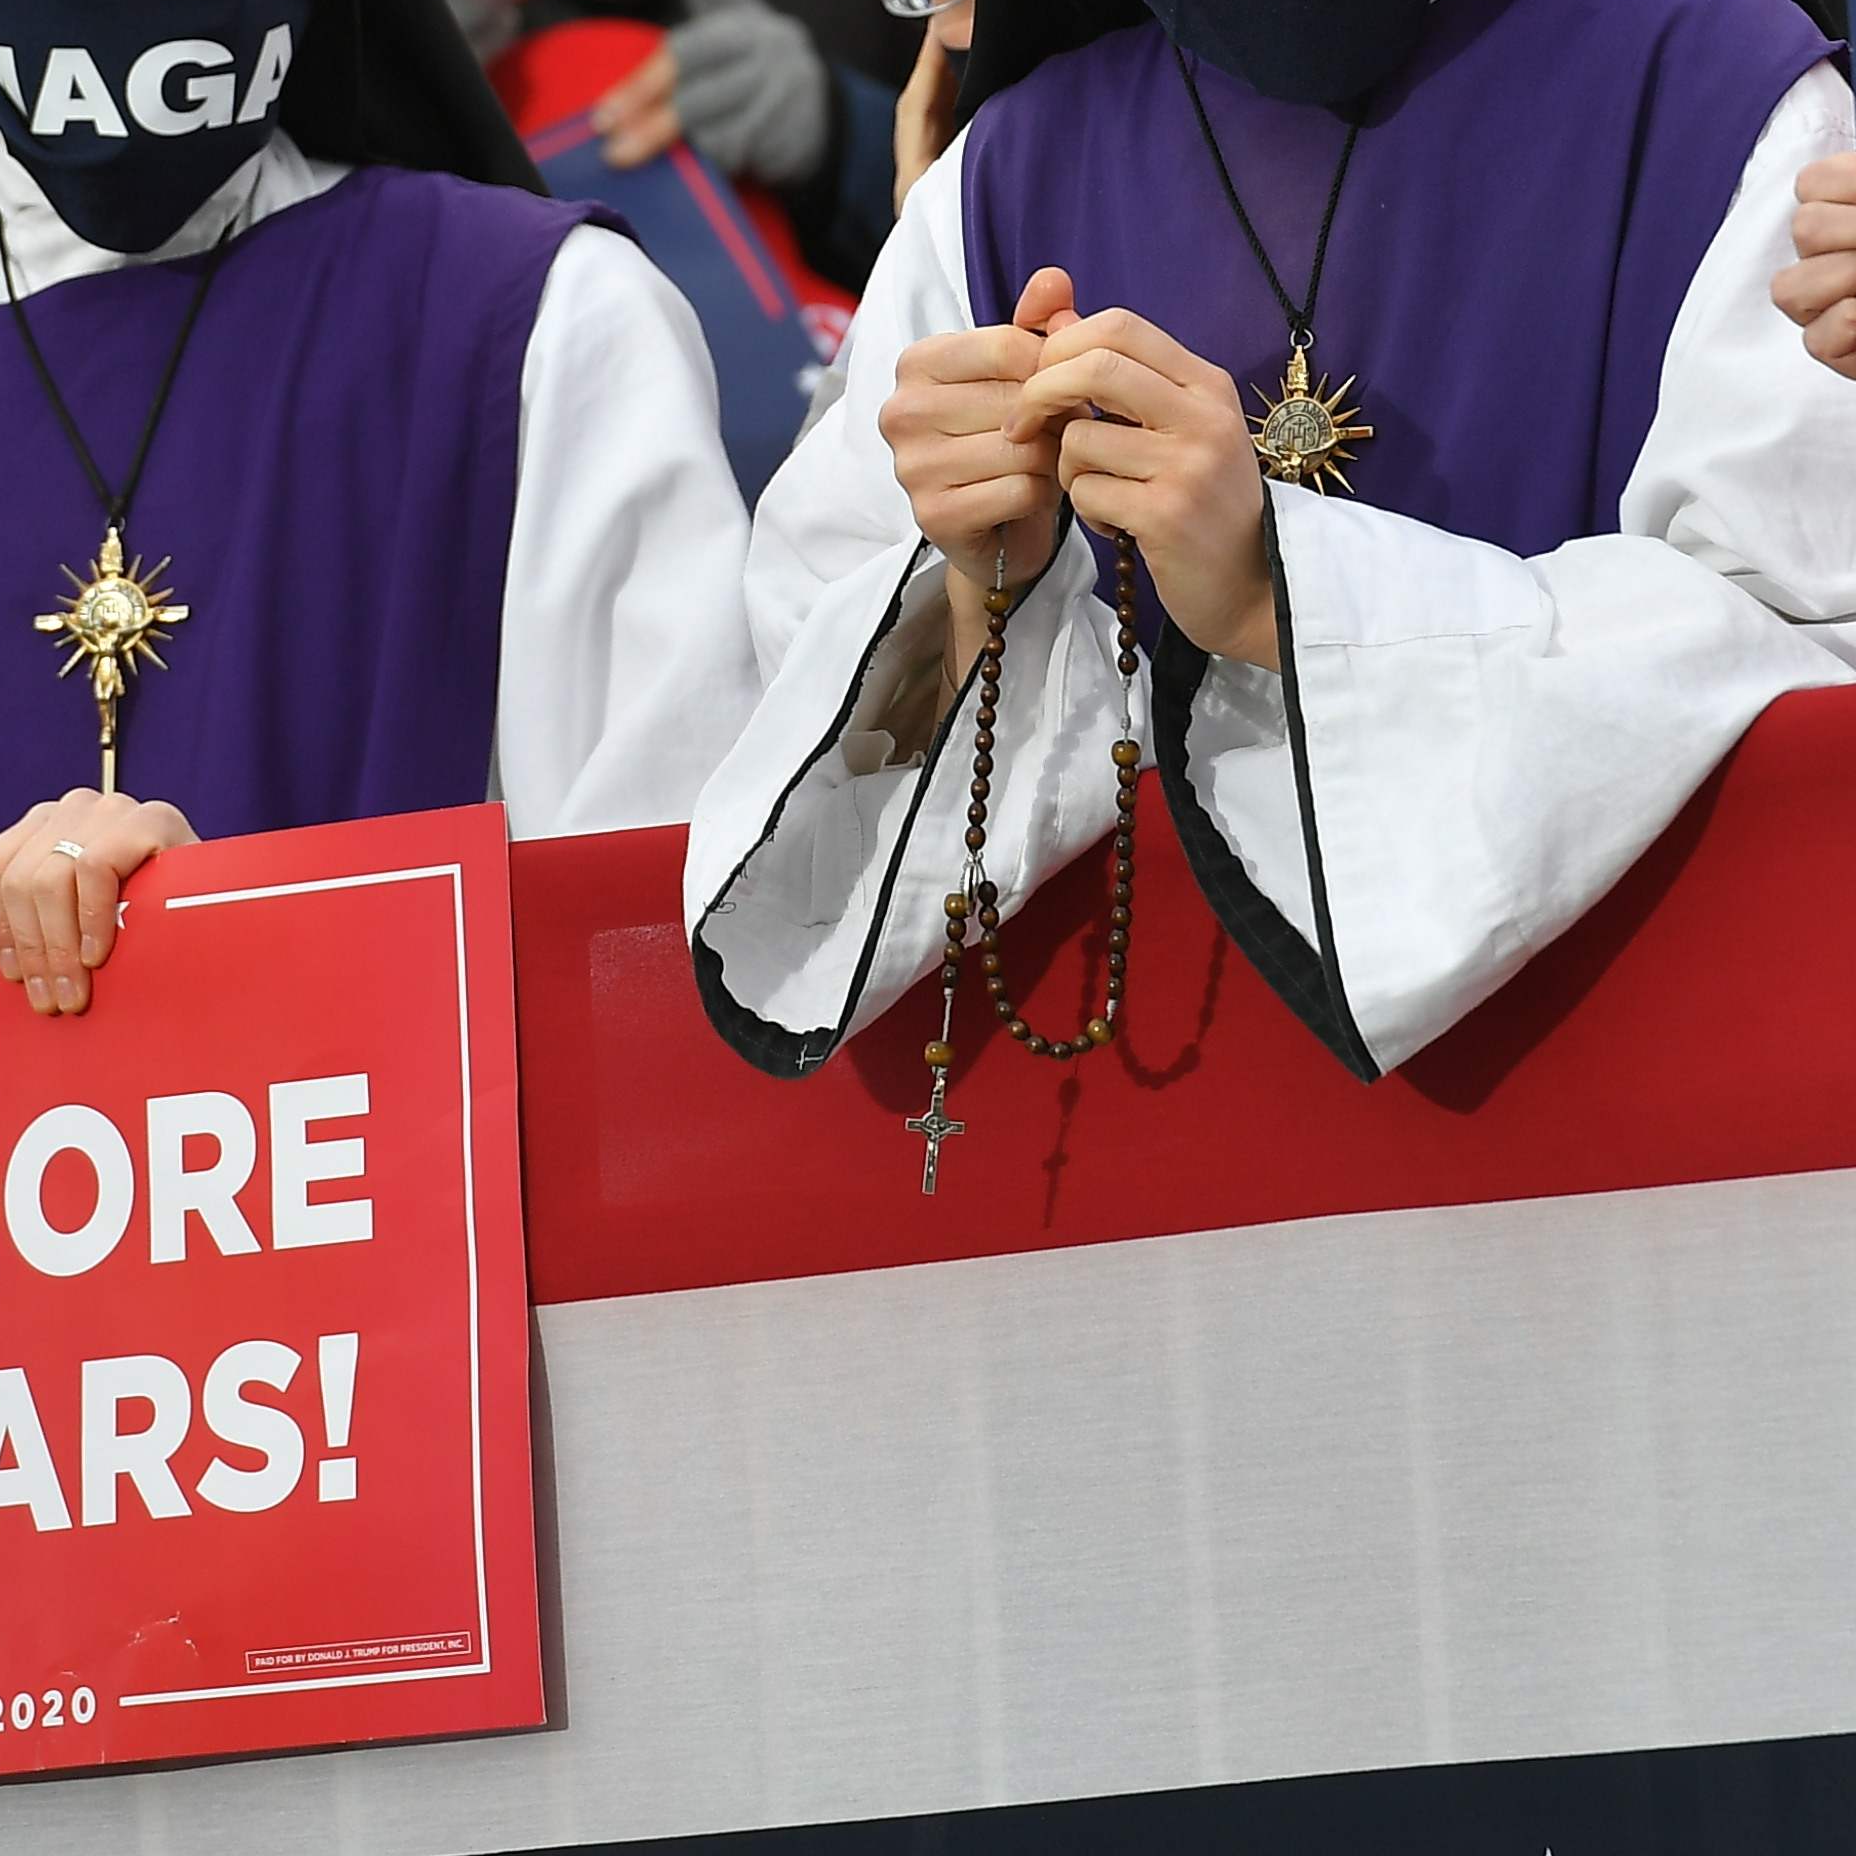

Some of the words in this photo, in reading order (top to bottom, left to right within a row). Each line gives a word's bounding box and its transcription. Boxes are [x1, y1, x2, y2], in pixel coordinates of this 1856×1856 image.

[255, 1657, 275, 1668] PAID
[276, 1655, 294, 1666] FOR
[295, 1653, 307, 1664] BY
[308, 1650, 343, 1663] DONALD
[345, 1648, 351, 1659] J.
[352, 1646, 381, 1659] TRUMP
[382, 1644, 400, 1656] FOR
[401, 1640, 448, 1655] PRESIDENT,
